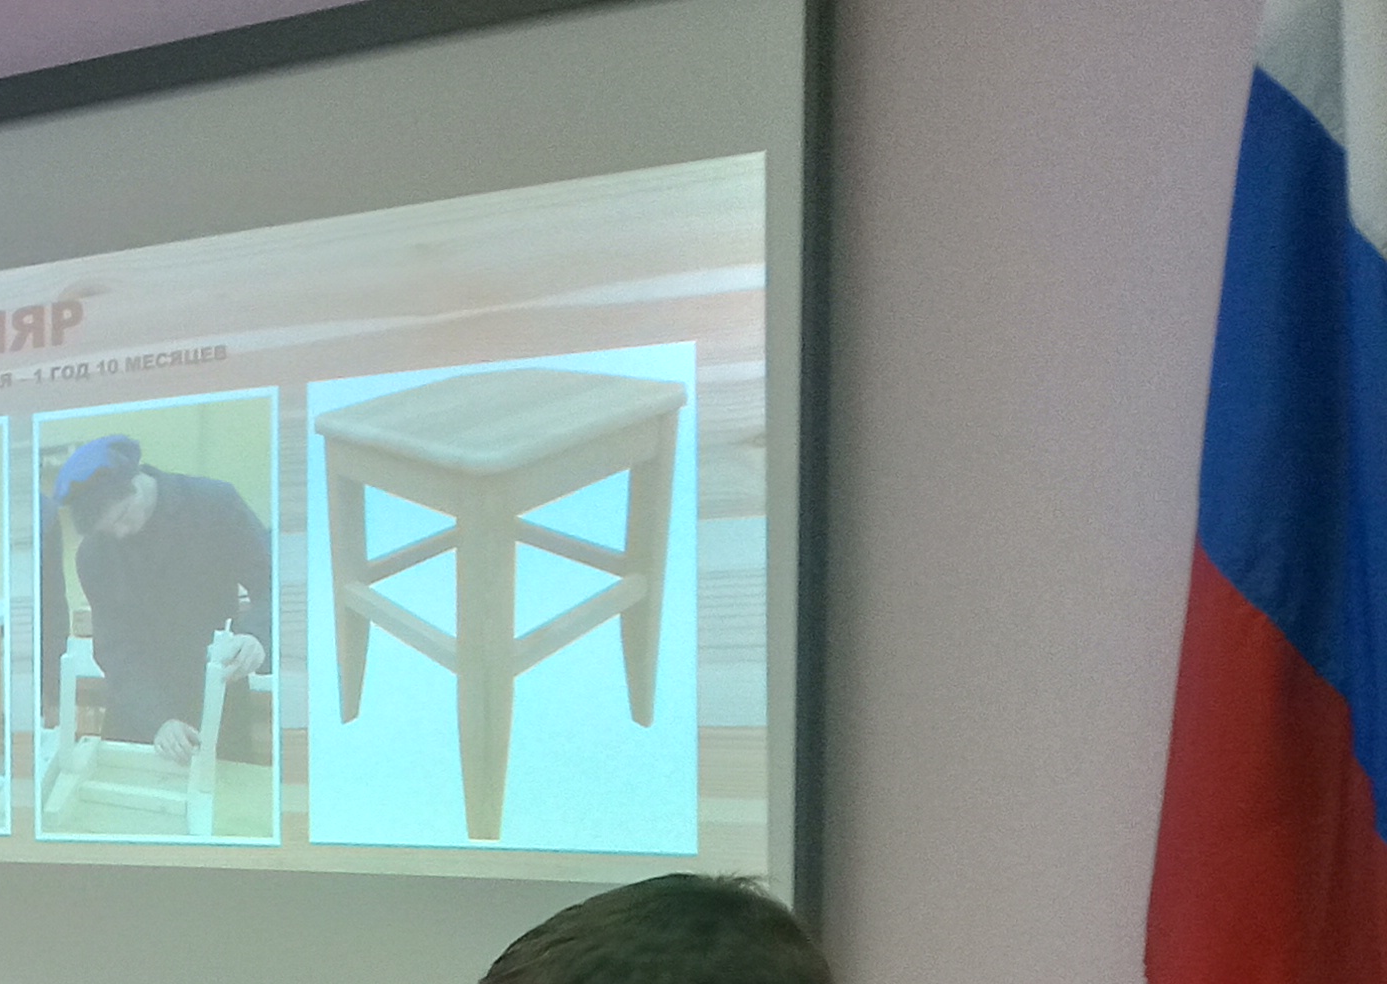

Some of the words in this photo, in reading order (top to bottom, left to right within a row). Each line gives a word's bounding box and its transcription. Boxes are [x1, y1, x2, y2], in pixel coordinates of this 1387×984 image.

[33, 368, 44, 384] 1
[50, 363, 90, 381] ГОД
[96, 358, 119, 376] 10
[125, 345, 228, 372] МЕСЯЦЕВ
